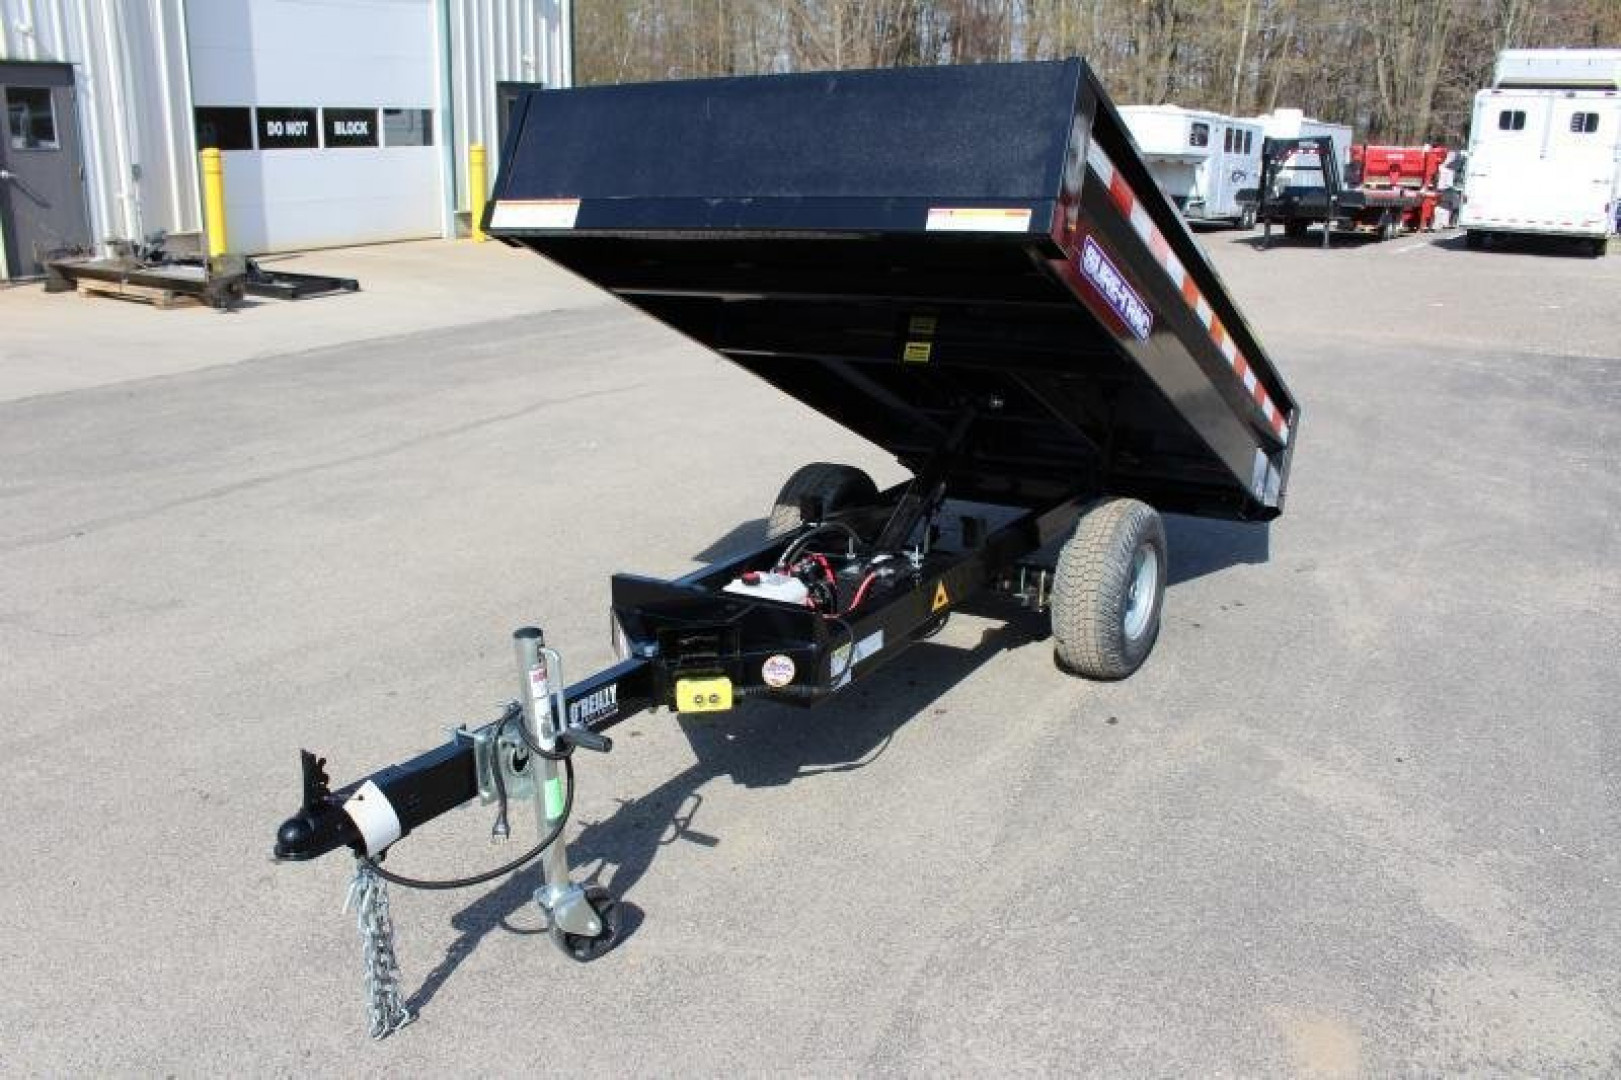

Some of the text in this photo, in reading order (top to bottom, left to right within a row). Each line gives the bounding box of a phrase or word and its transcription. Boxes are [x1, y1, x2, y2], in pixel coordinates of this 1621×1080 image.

[266, 121, 368, 136] DO NOT BLOCK
